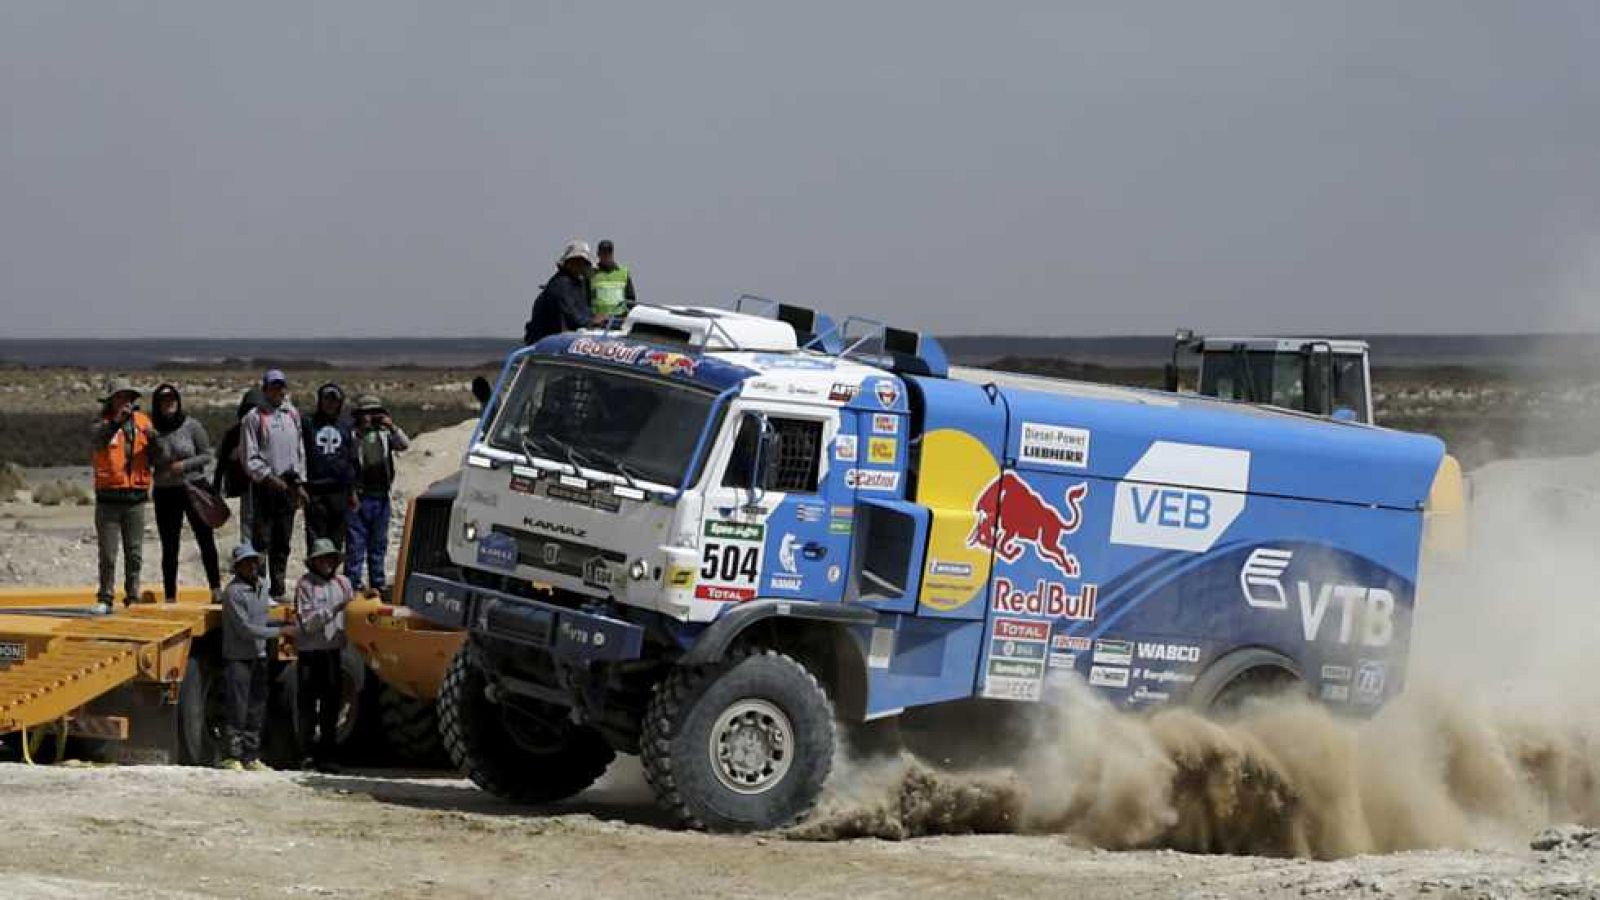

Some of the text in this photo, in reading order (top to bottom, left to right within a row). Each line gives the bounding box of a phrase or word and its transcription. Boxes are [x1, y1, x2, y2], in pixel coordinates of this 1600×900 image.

[1023, 446, 1084, 464] LIEBHERR
[1130, 486, 1212, 530] VEB
[522, 516, 589, 538] KAMAZ
[701, 543, 759, 583] 504
[706, 586, 742, 600] TOTAL
[992, 577, 1097, 620] Red Bull
[1297, 581, 1395, 646] VTB
[1000, 622, 1043, 638] TOTAL
[1137, 642, 1200, 662] WABCO
